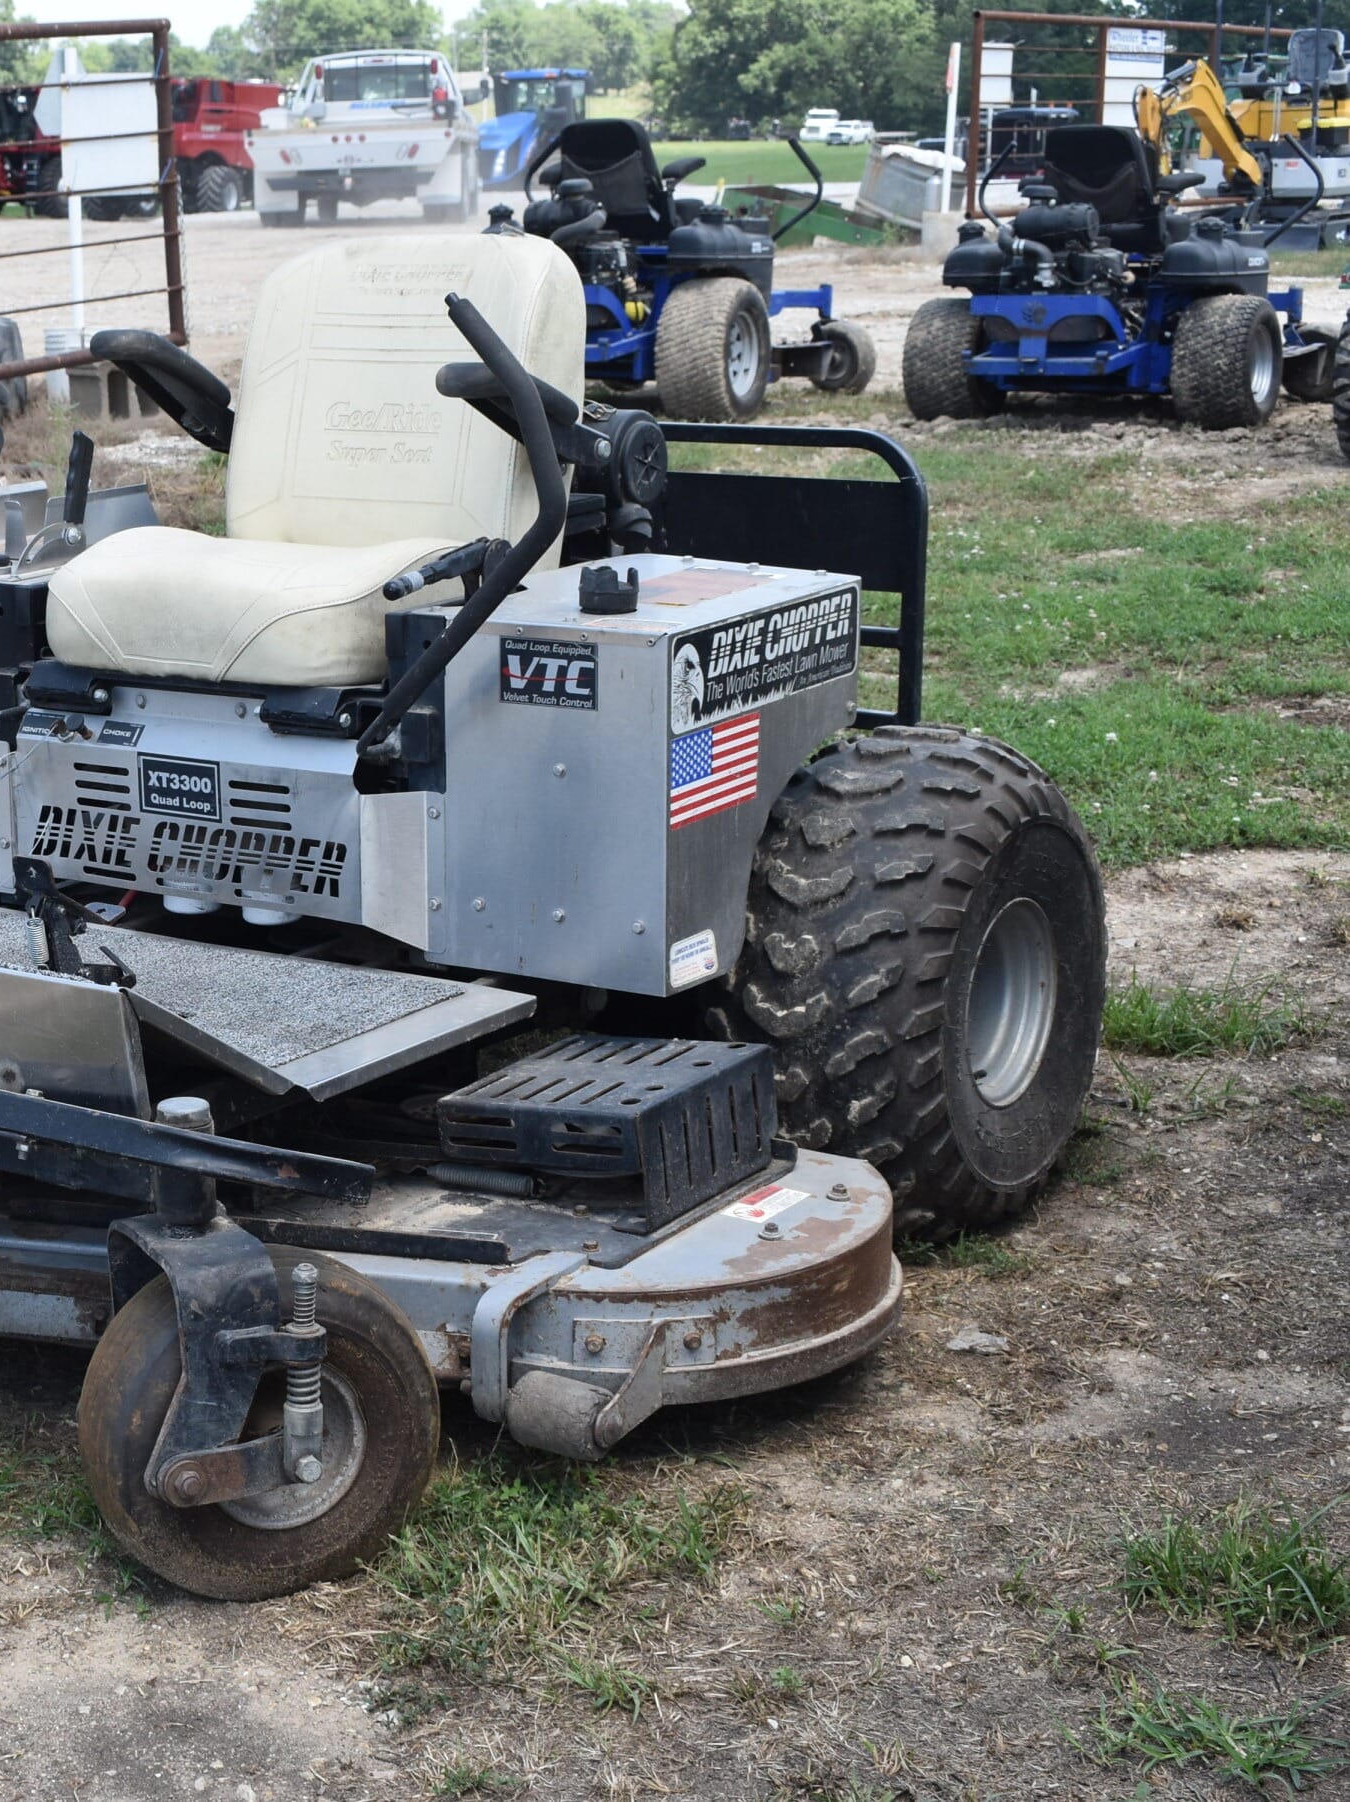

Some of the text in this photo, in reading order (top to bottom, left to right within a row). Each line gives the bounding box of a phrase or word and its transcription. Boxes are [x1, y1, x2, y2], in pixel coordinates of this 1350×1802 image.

[708, 593, 852, 679] DIXIE CHOPPER
[505, 640, 592, 656] Quad Loop Equipped
[507, 654, 595, 695] VTC
[707, 643, 849, 701] The World's Fastest Lawn Mower
[503, 691, 592, 708] Velvet Touch Control
[21, 726, 55, 737] IGNITIO
[103, 728, 132, 738] CHOKE
[148, 770, 211, 793] XT3300
[150, 793, 210, 813] Quad Loop
[32, 805, 348, 898] DIXIE CHOPPER
